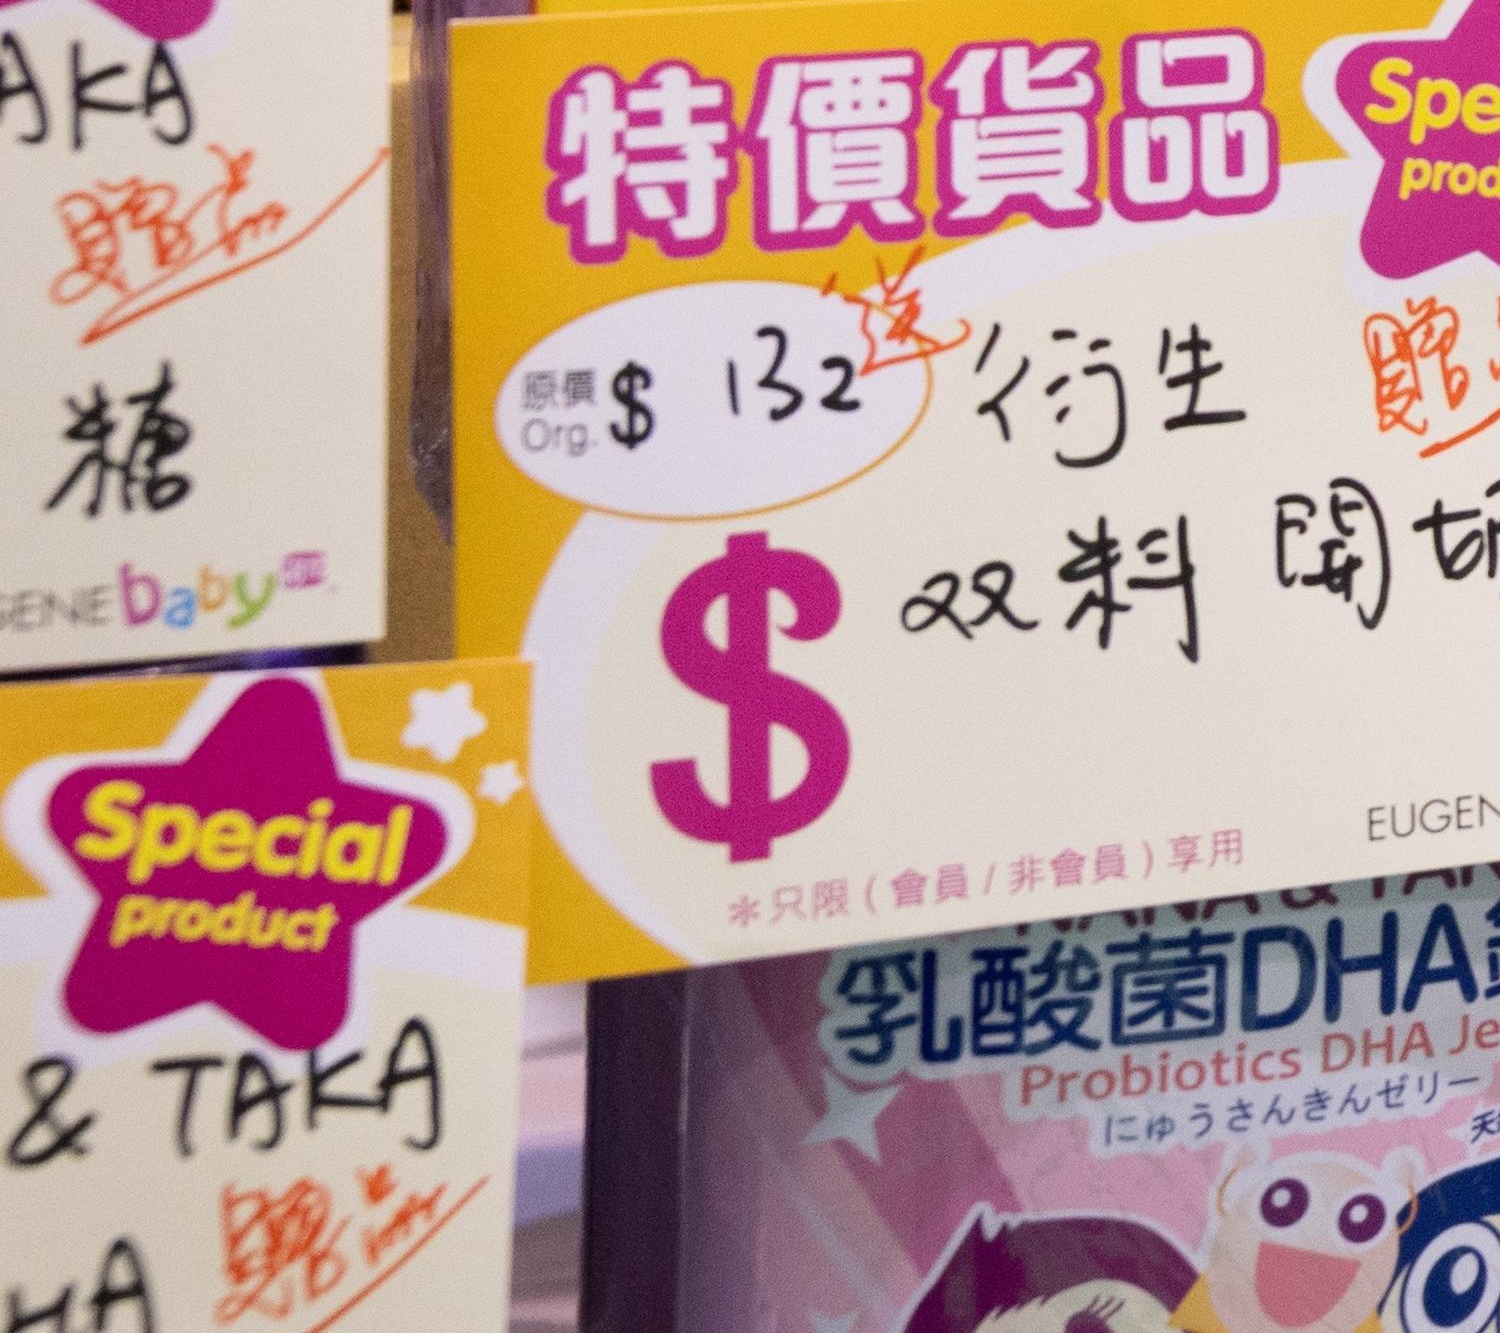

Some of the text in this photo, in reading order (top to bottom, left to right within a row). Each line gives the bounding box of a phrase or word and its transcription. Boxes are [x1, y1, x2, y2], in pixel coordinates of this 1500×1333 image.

[545, 26, 1280, 268] 特價貨品
[519, 417, 598, 458] Org.
[725, 327, 861, 422] 132
[521, 370, 597, 413] 原價
[121, 563, 276, 631] baby
[73, 779, 414, 887] Special
[110, 892, 337, 953] product
[1018, 1038, 1302, 1109] Probiotics
[1318, 1026, 1433, 1076] DHA
